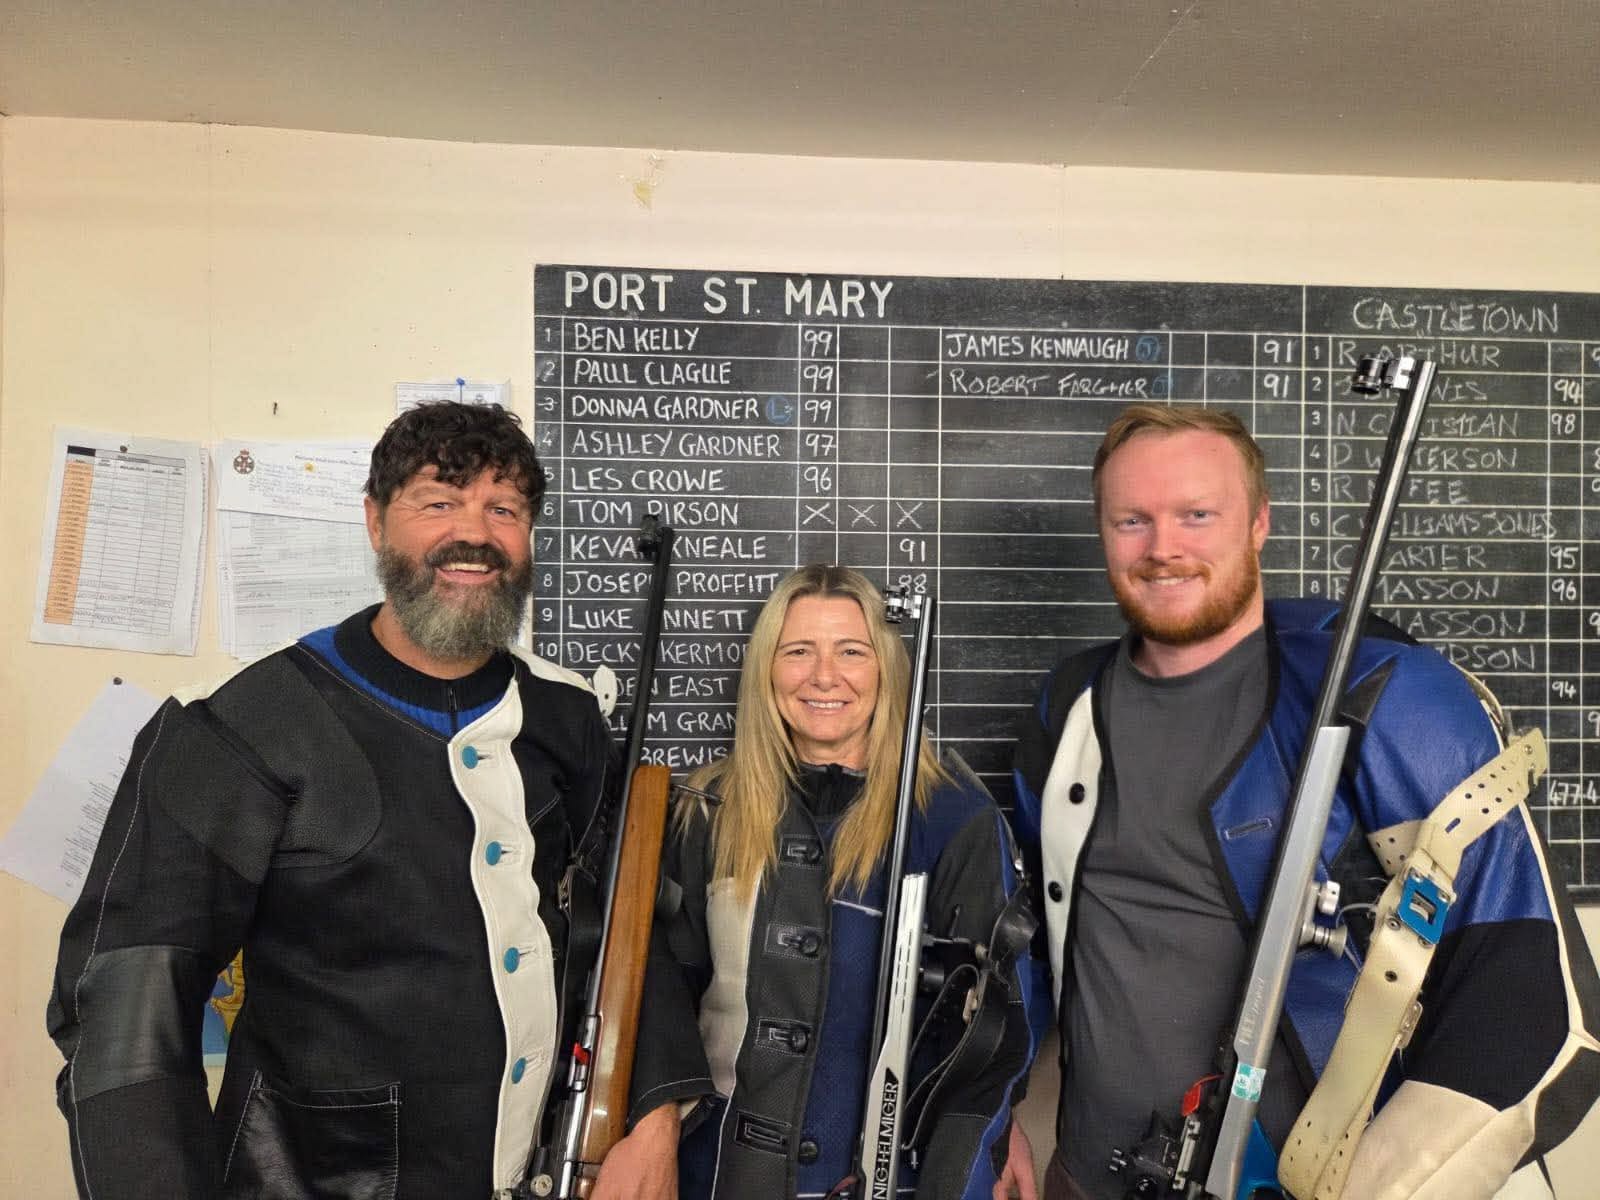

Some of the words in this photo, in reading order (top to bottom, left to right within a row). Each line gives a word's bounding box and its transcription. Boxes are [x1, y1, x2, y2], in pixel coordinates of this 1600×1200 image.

[565, 271, 674, 312] PORT
[703, 278, 761, 314] ST.
[785, 279, 894, 318] MARY
[1353, 297, 1559, 333] CASTLETOWN
[545, 327, 551, 342] 1
[574, 322, 626, 352] BEN
[635, 326, 699, 352] KELLY
[804, 330, 832, 357] 99
[945, 333, 1024, 358] JAMES
[1031, 336, 1129, 360] KENNAUGH
[1264, 340, 1292, 363] 91
[1313, 345, 1320, 360] 1
[1339, 341, 1357, 366] R
[544, 361, 556, 376] 2
[574, 358, 637, 385] PAUL
[645, 360, 731, 385] CLAGUE
[804, 365, 833, 392] 99
[950, 367, 1049, 395] ROBERT
[1264, 373, 1290, 398] 91
[1312, 376, 1321, 391] 2
[1554, 379, 1583, 404] 94
[572, 395, 649, 418] DONNA
[654, 396, 759, 421] GARDNER
[804, 399, 832, 424] 99
[1311, 410, 1321, 425] 3
[1337, 408, 1355, 435] N
[1551, 412, 1576, 435] 98
[542, 431, 553, 446] 4
[572, 429, 672, 457] ASHLEY
[679, 433, 781, 459] GARDNER
[805, 433, 836, 457] 97
[1310, 444, 1320, 459] 4
[1333, 442, 1352, 468] D
[543, 466, 555, 481] 5
[571, 467, 622, 491] LES
[631, 467, 724, 491] CROWE
[804, 467, 832, 493] 96
[1311, 477, 1320, 492] 5
[1333, 474, 1354, 500] R
[543, 502, 554, 516] 6
[568, 500, 632, 525] TOM
[1310, 512, 1320, 526] 6
[1332, 514, 1350, 537] C
[543, 537, 553, 551] 7
[570, 534, 645, 560] KEVA
[900, 538, 925, 562] 91
[1311, 546, 1320, 560] 7
[1384, 543, 1486, 571] ARTER
[1550, 545, 1579, 569] 95
[543, 573, 553, 588] 8
[677, 571, 778, 595] PROFFITT
[1310, 580, 1320, 594] 8
[1552, 578, 1577, 601] 96
[542, 607, 553, 622] 9
[568, 604, 633, 629] LUKE
[538, 642, 558, 657] 10
[567, 640, 641, 663] DECK
[660, 640, 747, 665] KERMO
[669, 675, 729, 698] EAST
[1552, 680, 1577, 699] 94
